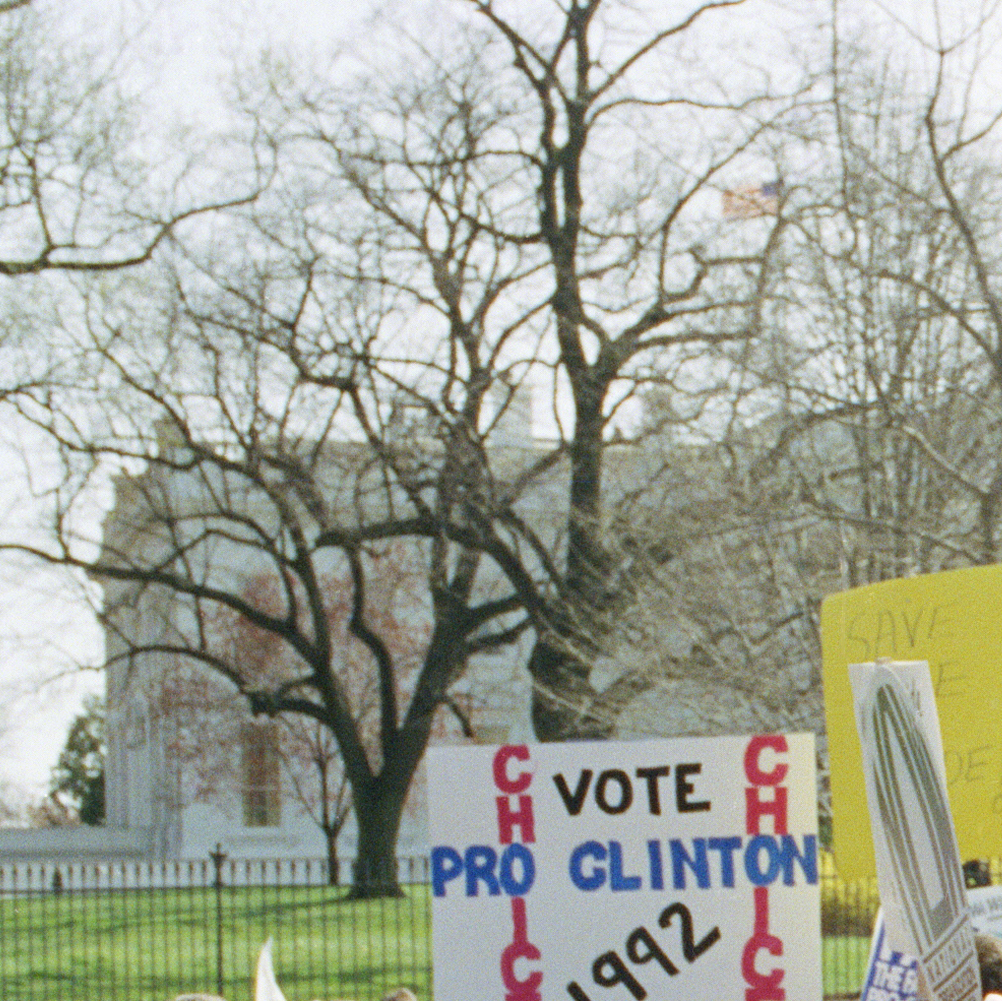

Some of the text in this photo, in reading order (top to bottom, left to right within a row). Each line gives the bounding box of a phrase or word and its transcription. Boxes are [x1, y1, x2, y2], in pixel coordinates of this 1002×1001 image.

[552, 763, 711, 816] VOTE
[430, 834, 819, 898] PRO CLINTON
